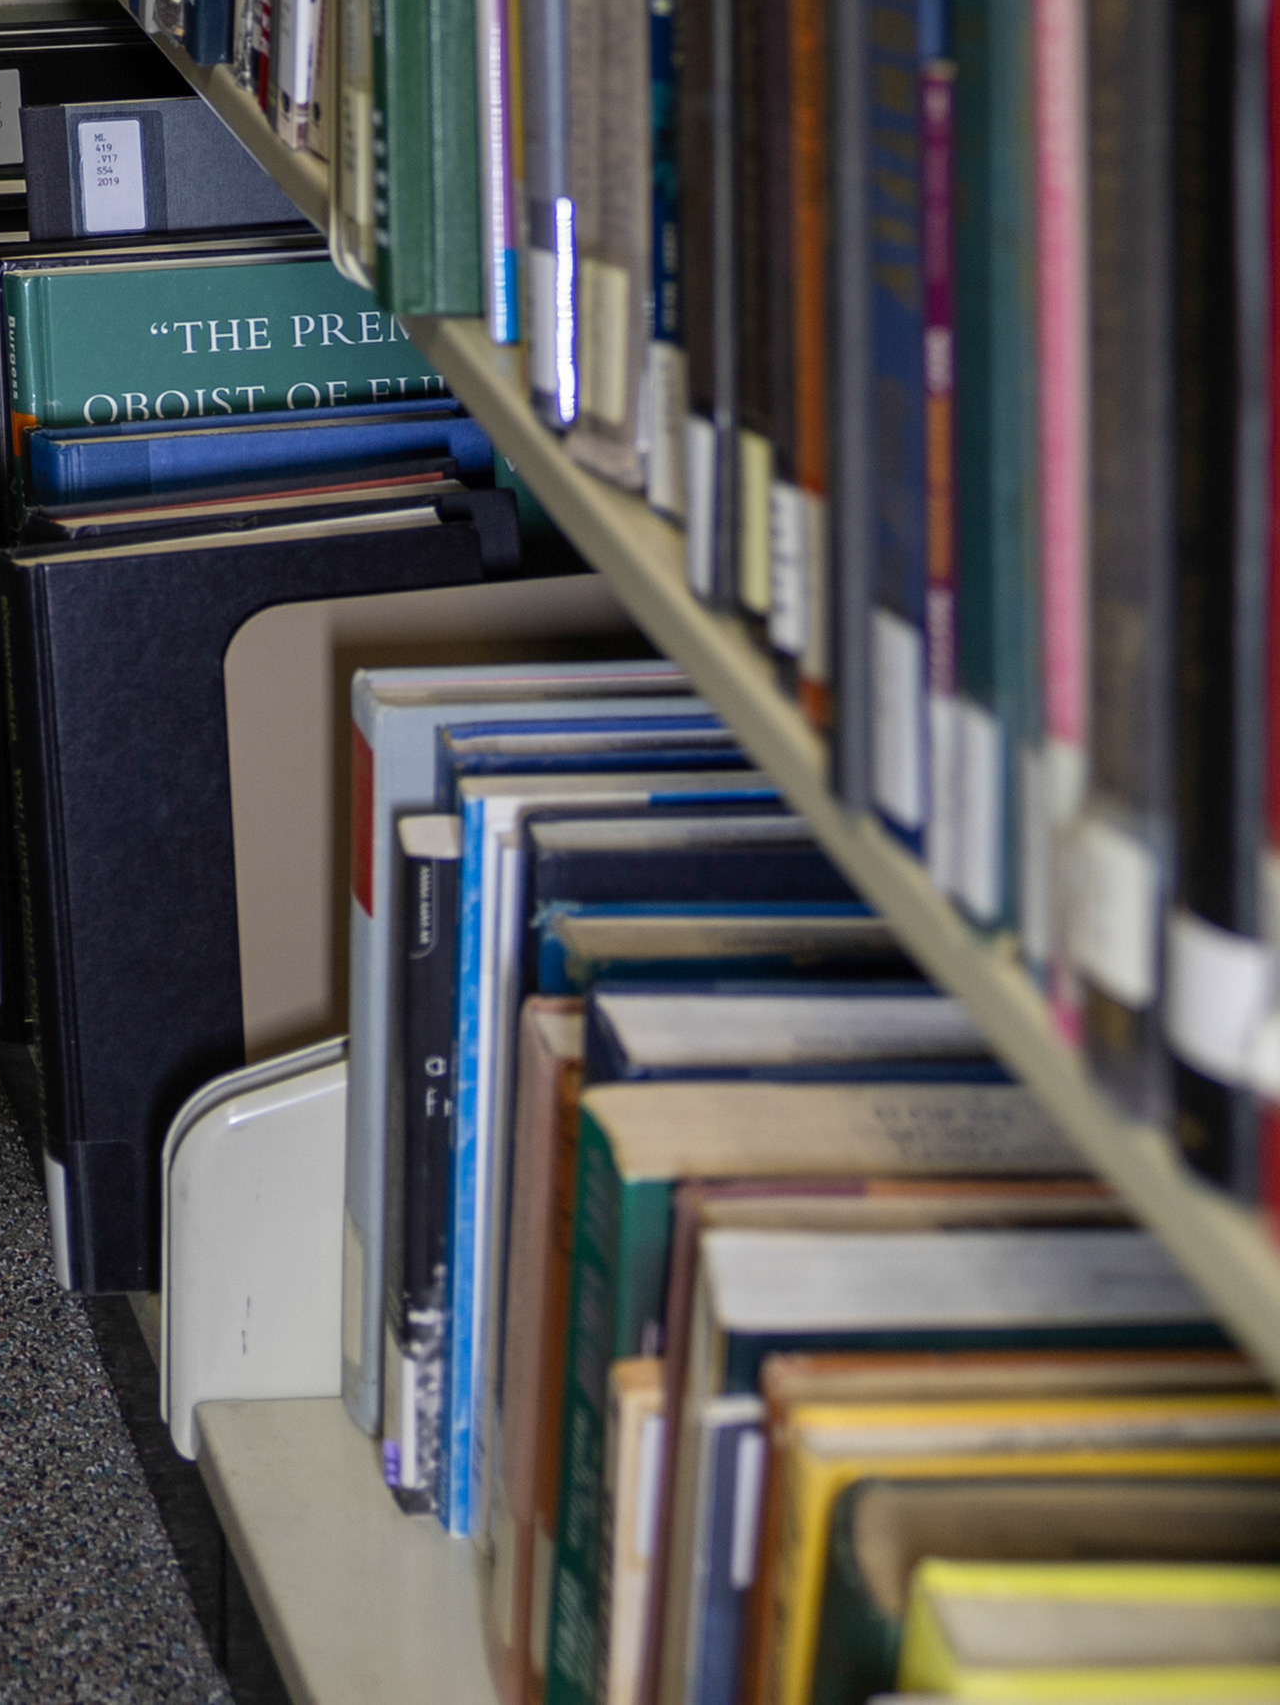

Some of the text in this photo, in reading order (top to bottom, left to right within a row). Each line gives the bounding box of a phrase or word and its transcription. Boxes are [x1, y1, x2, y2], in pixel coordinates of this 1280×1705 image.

[94, 134, 107, 142] ML
[95, 143, 113, 153] 419
[97, 153, 118, 164] .V17
[96, 166, 113, 176] S54
[97, 177, 120, 187] 2019
[149, 317, 272, 355] “THE
[7, 315, 19, 401] Burgess
[83, 385, 267, 426] OBOIST
